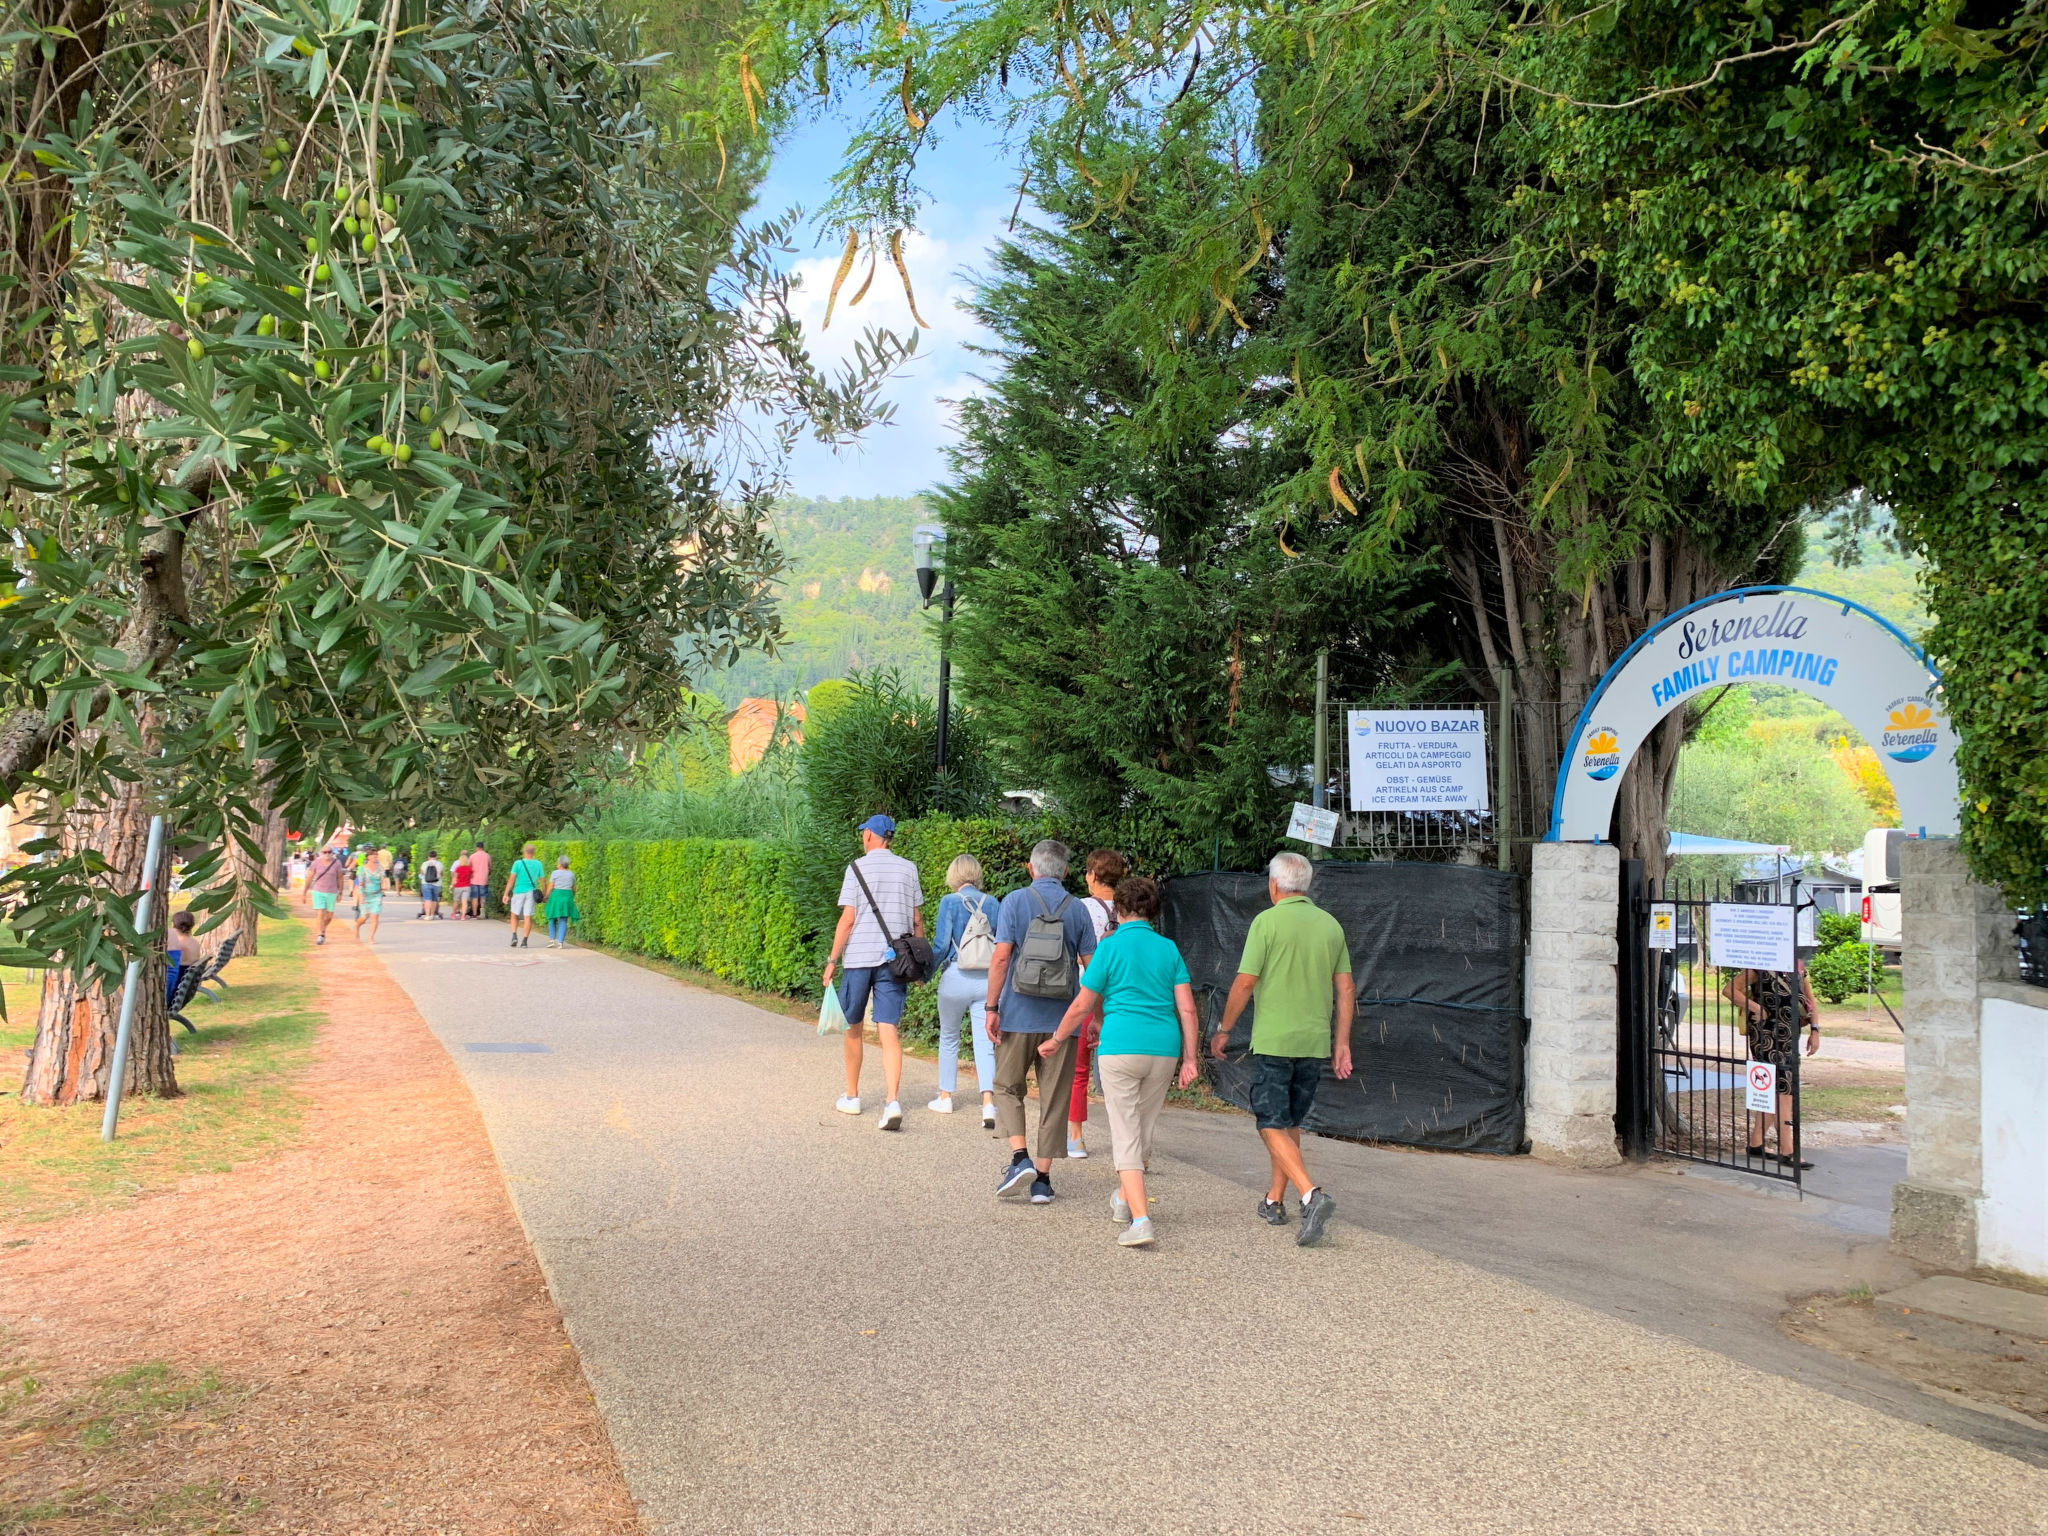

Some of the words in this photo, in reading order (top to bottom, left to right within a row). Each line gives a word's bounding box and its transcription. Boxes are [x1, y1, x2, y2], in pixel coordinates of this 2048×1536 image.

[1678, 601, 1808, 659] Serenella
[1651, 655, 1720, 707] FAMILY
[1728, 649, 1838, 687] CAMPING
[1375, 720, 1427, 733] NUOVO
[1431, 720, 1480, 732] BAZAR
[1882, 728, 1938, 747] Serenella
[1378, 742, 1411, 750] FRUTTA
[1417, 741, 1458, 749] VERDURA
[1365, 751, 1405, 759] ARTICOLI
[1406, 751, 1419, 759] DA
[1375, 761, 1406, 769] GELATI
[1408, 761, 1420, 769] DA
[1421, 760, 1462, 769] ASPORTO
[1583, 753, 1620, 767] Serenella
[1386, 776, 1409, 784] OBST
[1416, 775, 1453, 783] GEMÜSE
[1375, 786, 1418, 794] ARTIKELN
[1419, 785, 1437, 793] AUS
[1438, 785, 1464, 793] CAMP
[1372, 795, 1386, 803] ICE
[1388, 795, 1419, 803] CREAM
[1420, 795, 1443, 803] TAKE
[1445, 794, 1469, 803] AWAY
